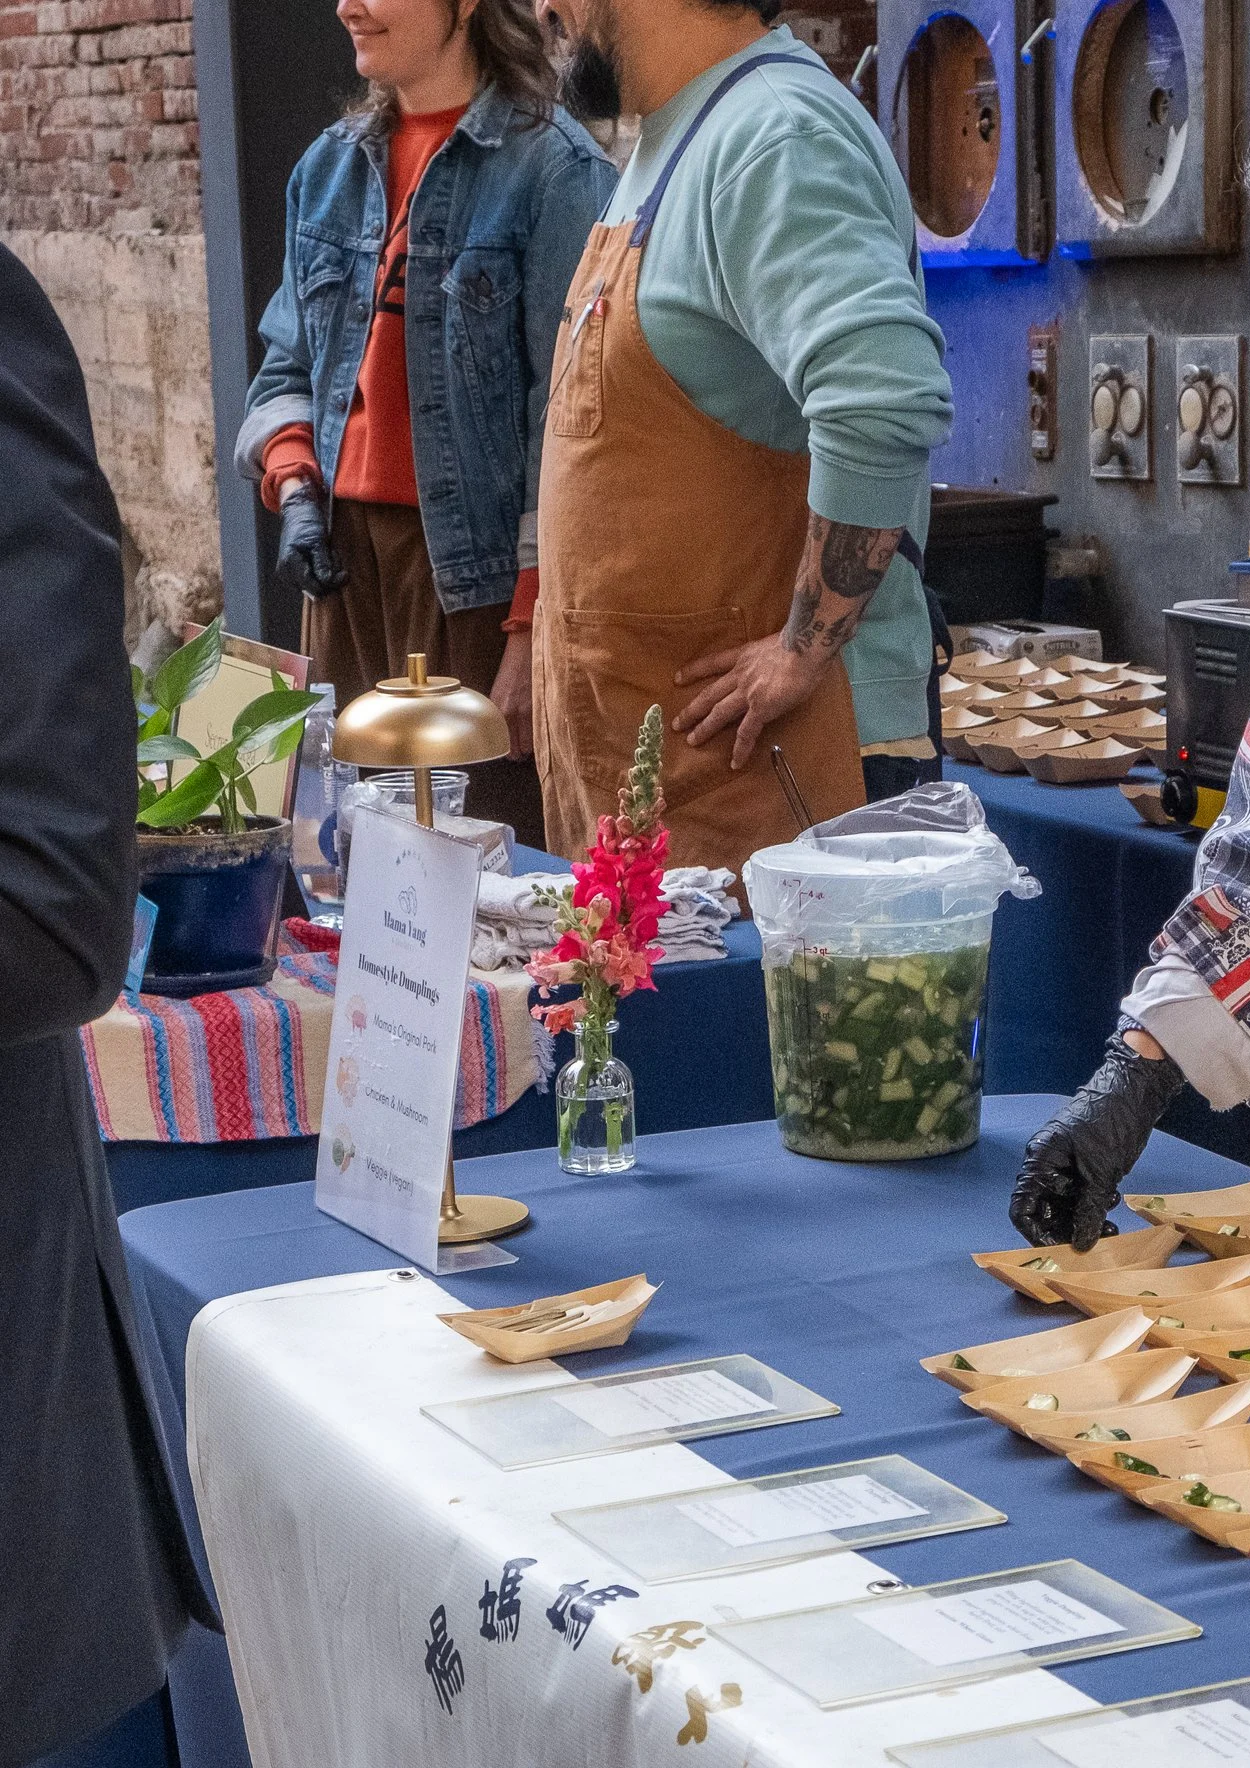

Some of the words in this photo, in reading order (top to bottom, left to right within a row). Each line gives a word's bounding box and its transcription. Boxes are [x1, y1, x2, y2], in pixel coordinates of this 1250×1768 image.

[408, 920, 428, 948] Yang
[357, 953, 399, 985] Homestyle
[398, 970, 440, 1007] Dumplings
[372, 1013, 397, 1036] Mama's
[397, 1024, 422, 1050] Original
[422, 1036, 437, 1054] Pork
[365, 1086, 390, 1107] Chicken
[390, 1095, 396, 1109] &
[397, 1100, 429, 1126] Mushroom
[366, 1157, 388, 1180] Veggie
[388, 1170, 414, 1197] (vegan)
